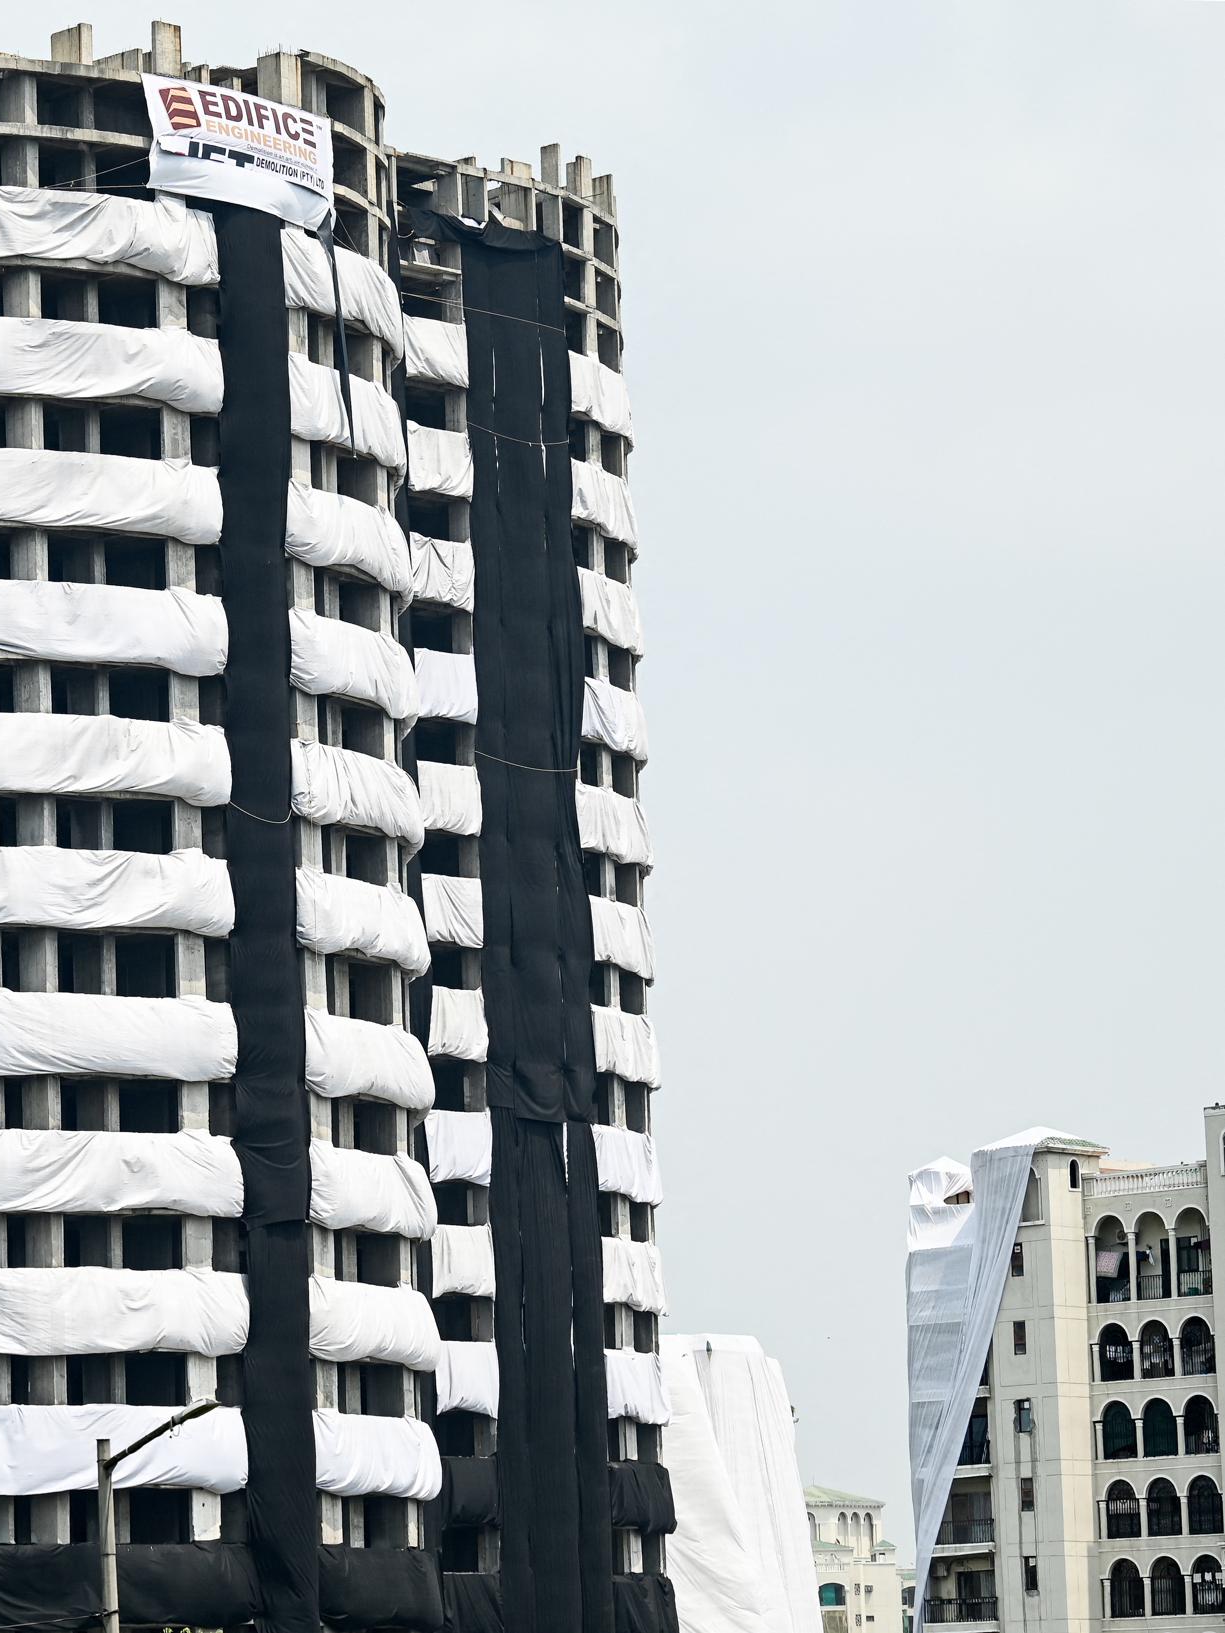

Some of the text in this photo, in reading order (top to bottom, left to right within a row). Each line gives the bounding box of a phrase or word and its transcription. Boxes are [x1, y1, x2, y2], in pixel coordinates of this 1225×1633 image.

[197, 89, 317, 149] EDIFICE
[205, 119, 318, 166] ENGINEERING
[256, 157, 298, 178] DEMOLITION
[299, 170, 316, 187] (PTY)
